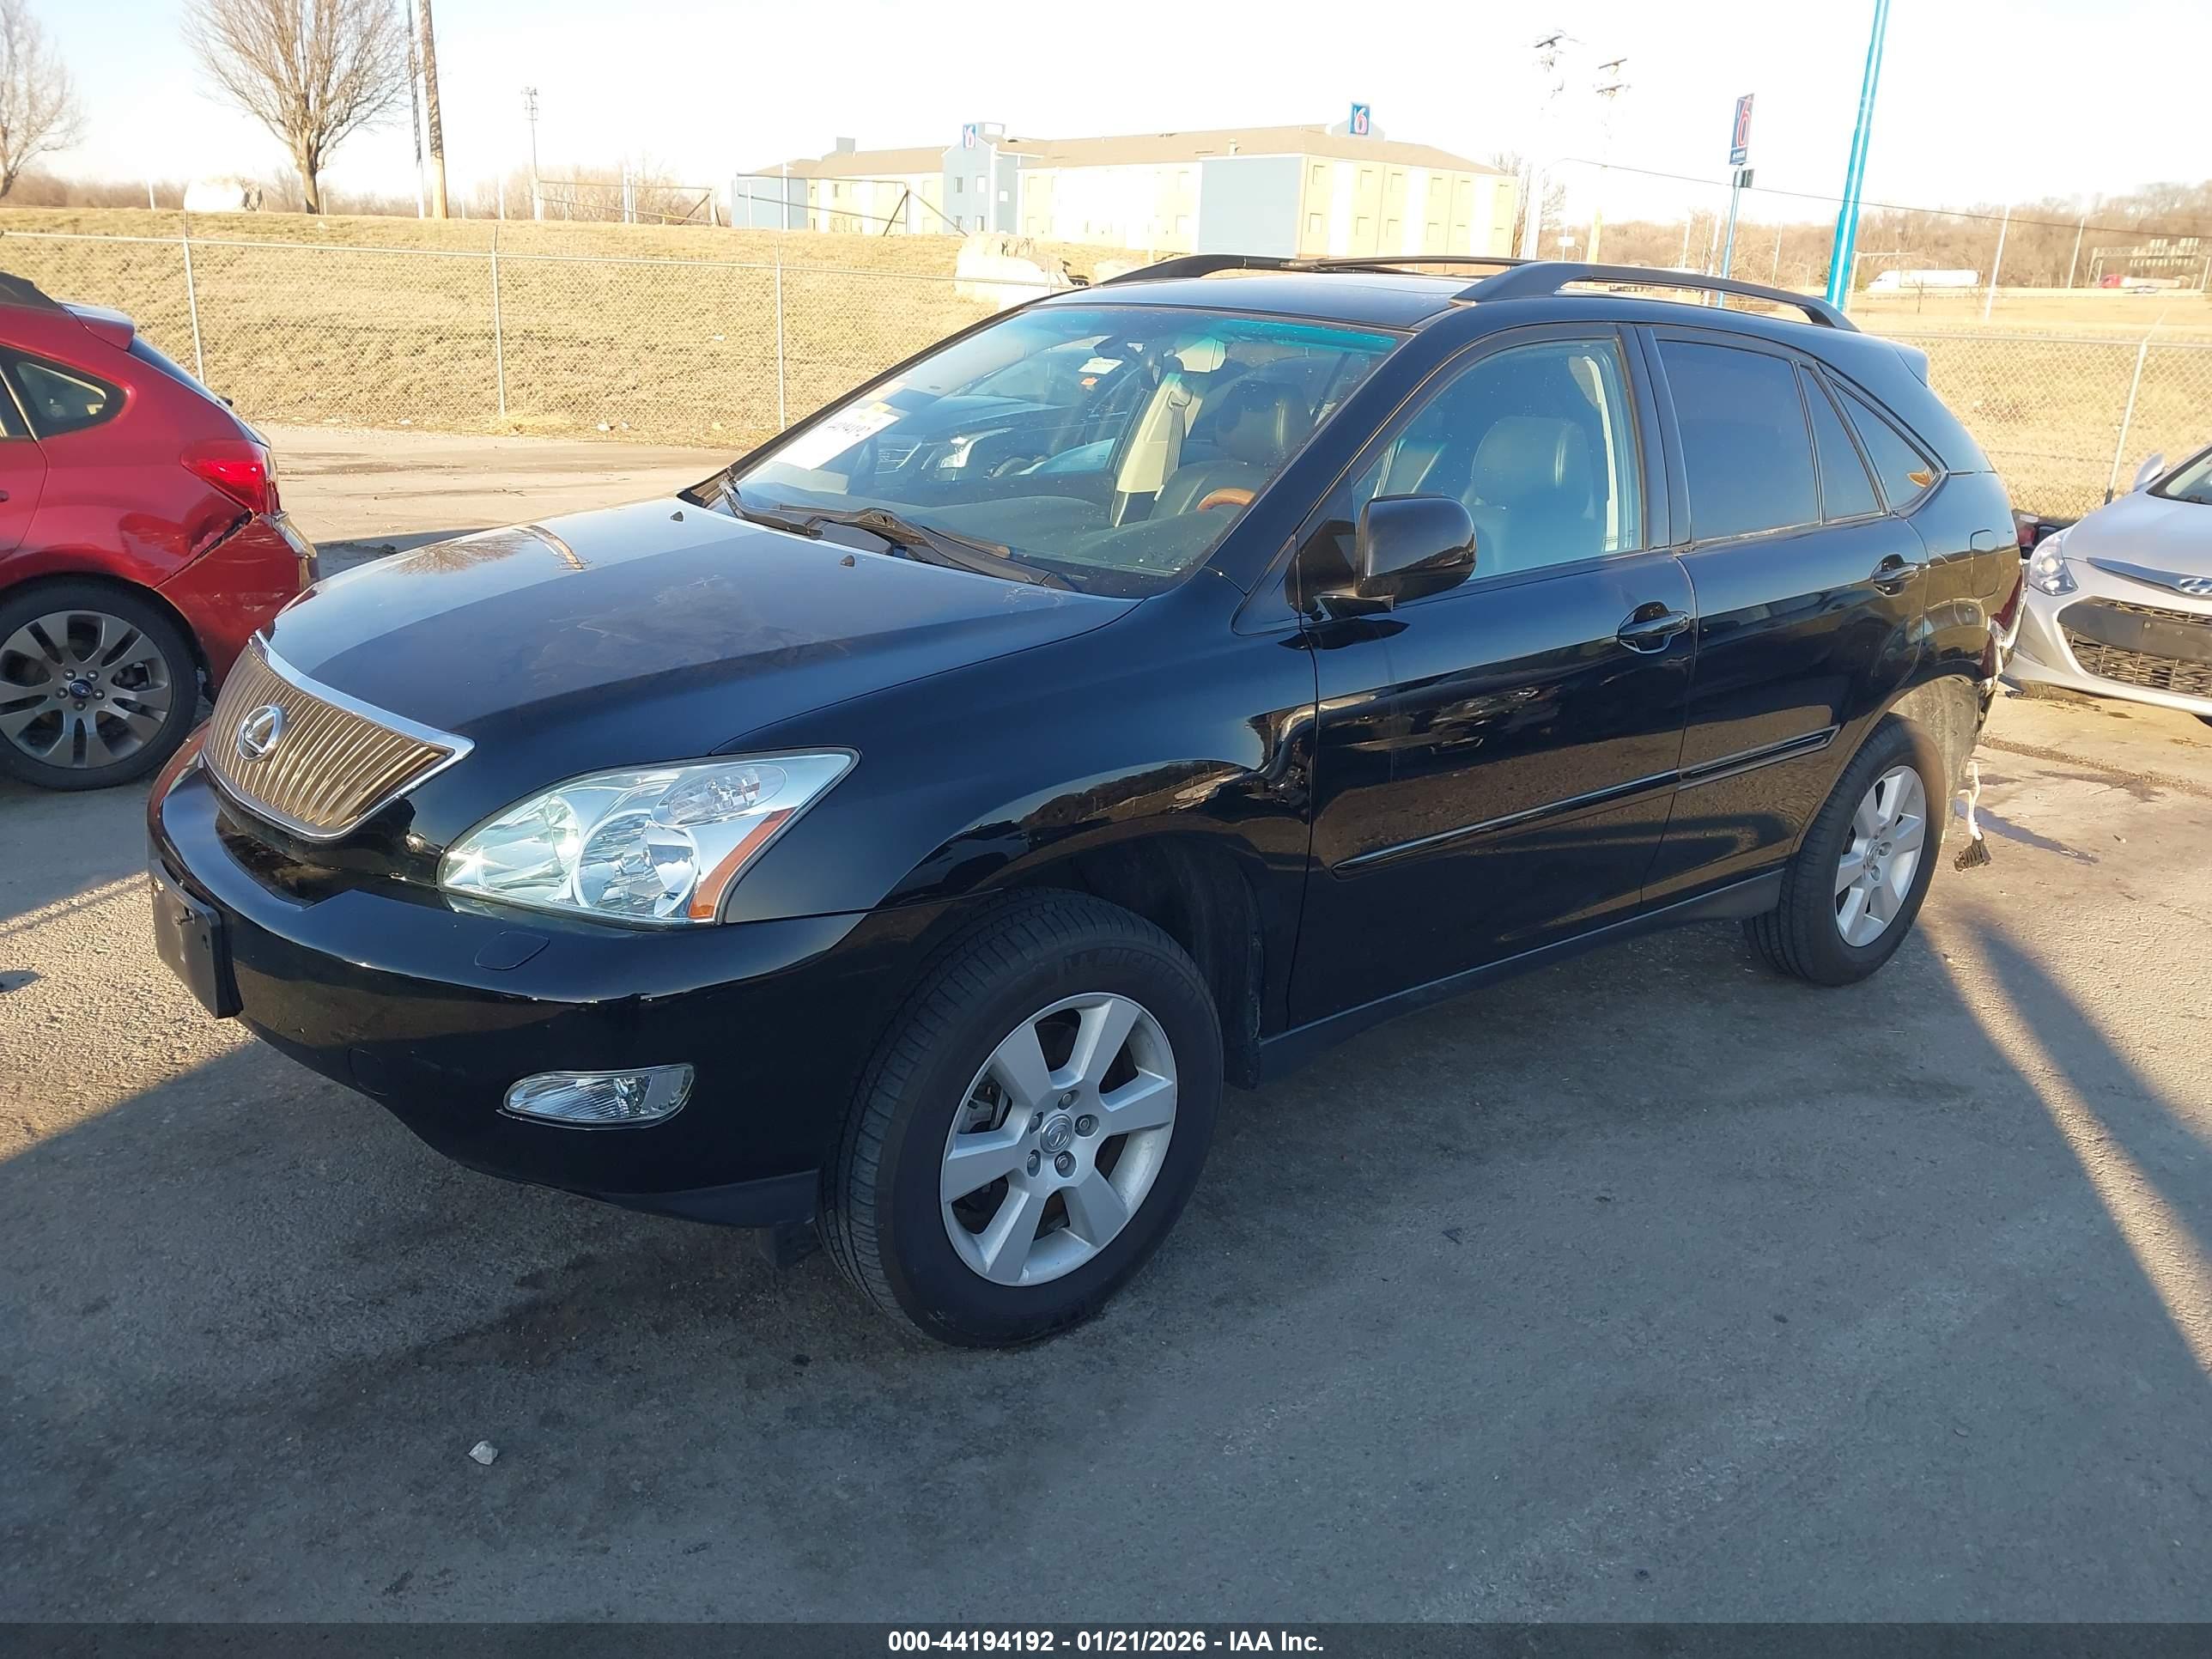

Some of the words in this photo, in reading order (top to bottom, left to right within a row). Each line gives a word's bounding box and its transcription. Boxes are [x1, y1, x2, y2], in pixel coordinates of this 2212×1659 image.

[1354, 107, 1367, 134] 6
[1736, 94, 1751, 148] 6
[965, 125, 975, 148] 6
